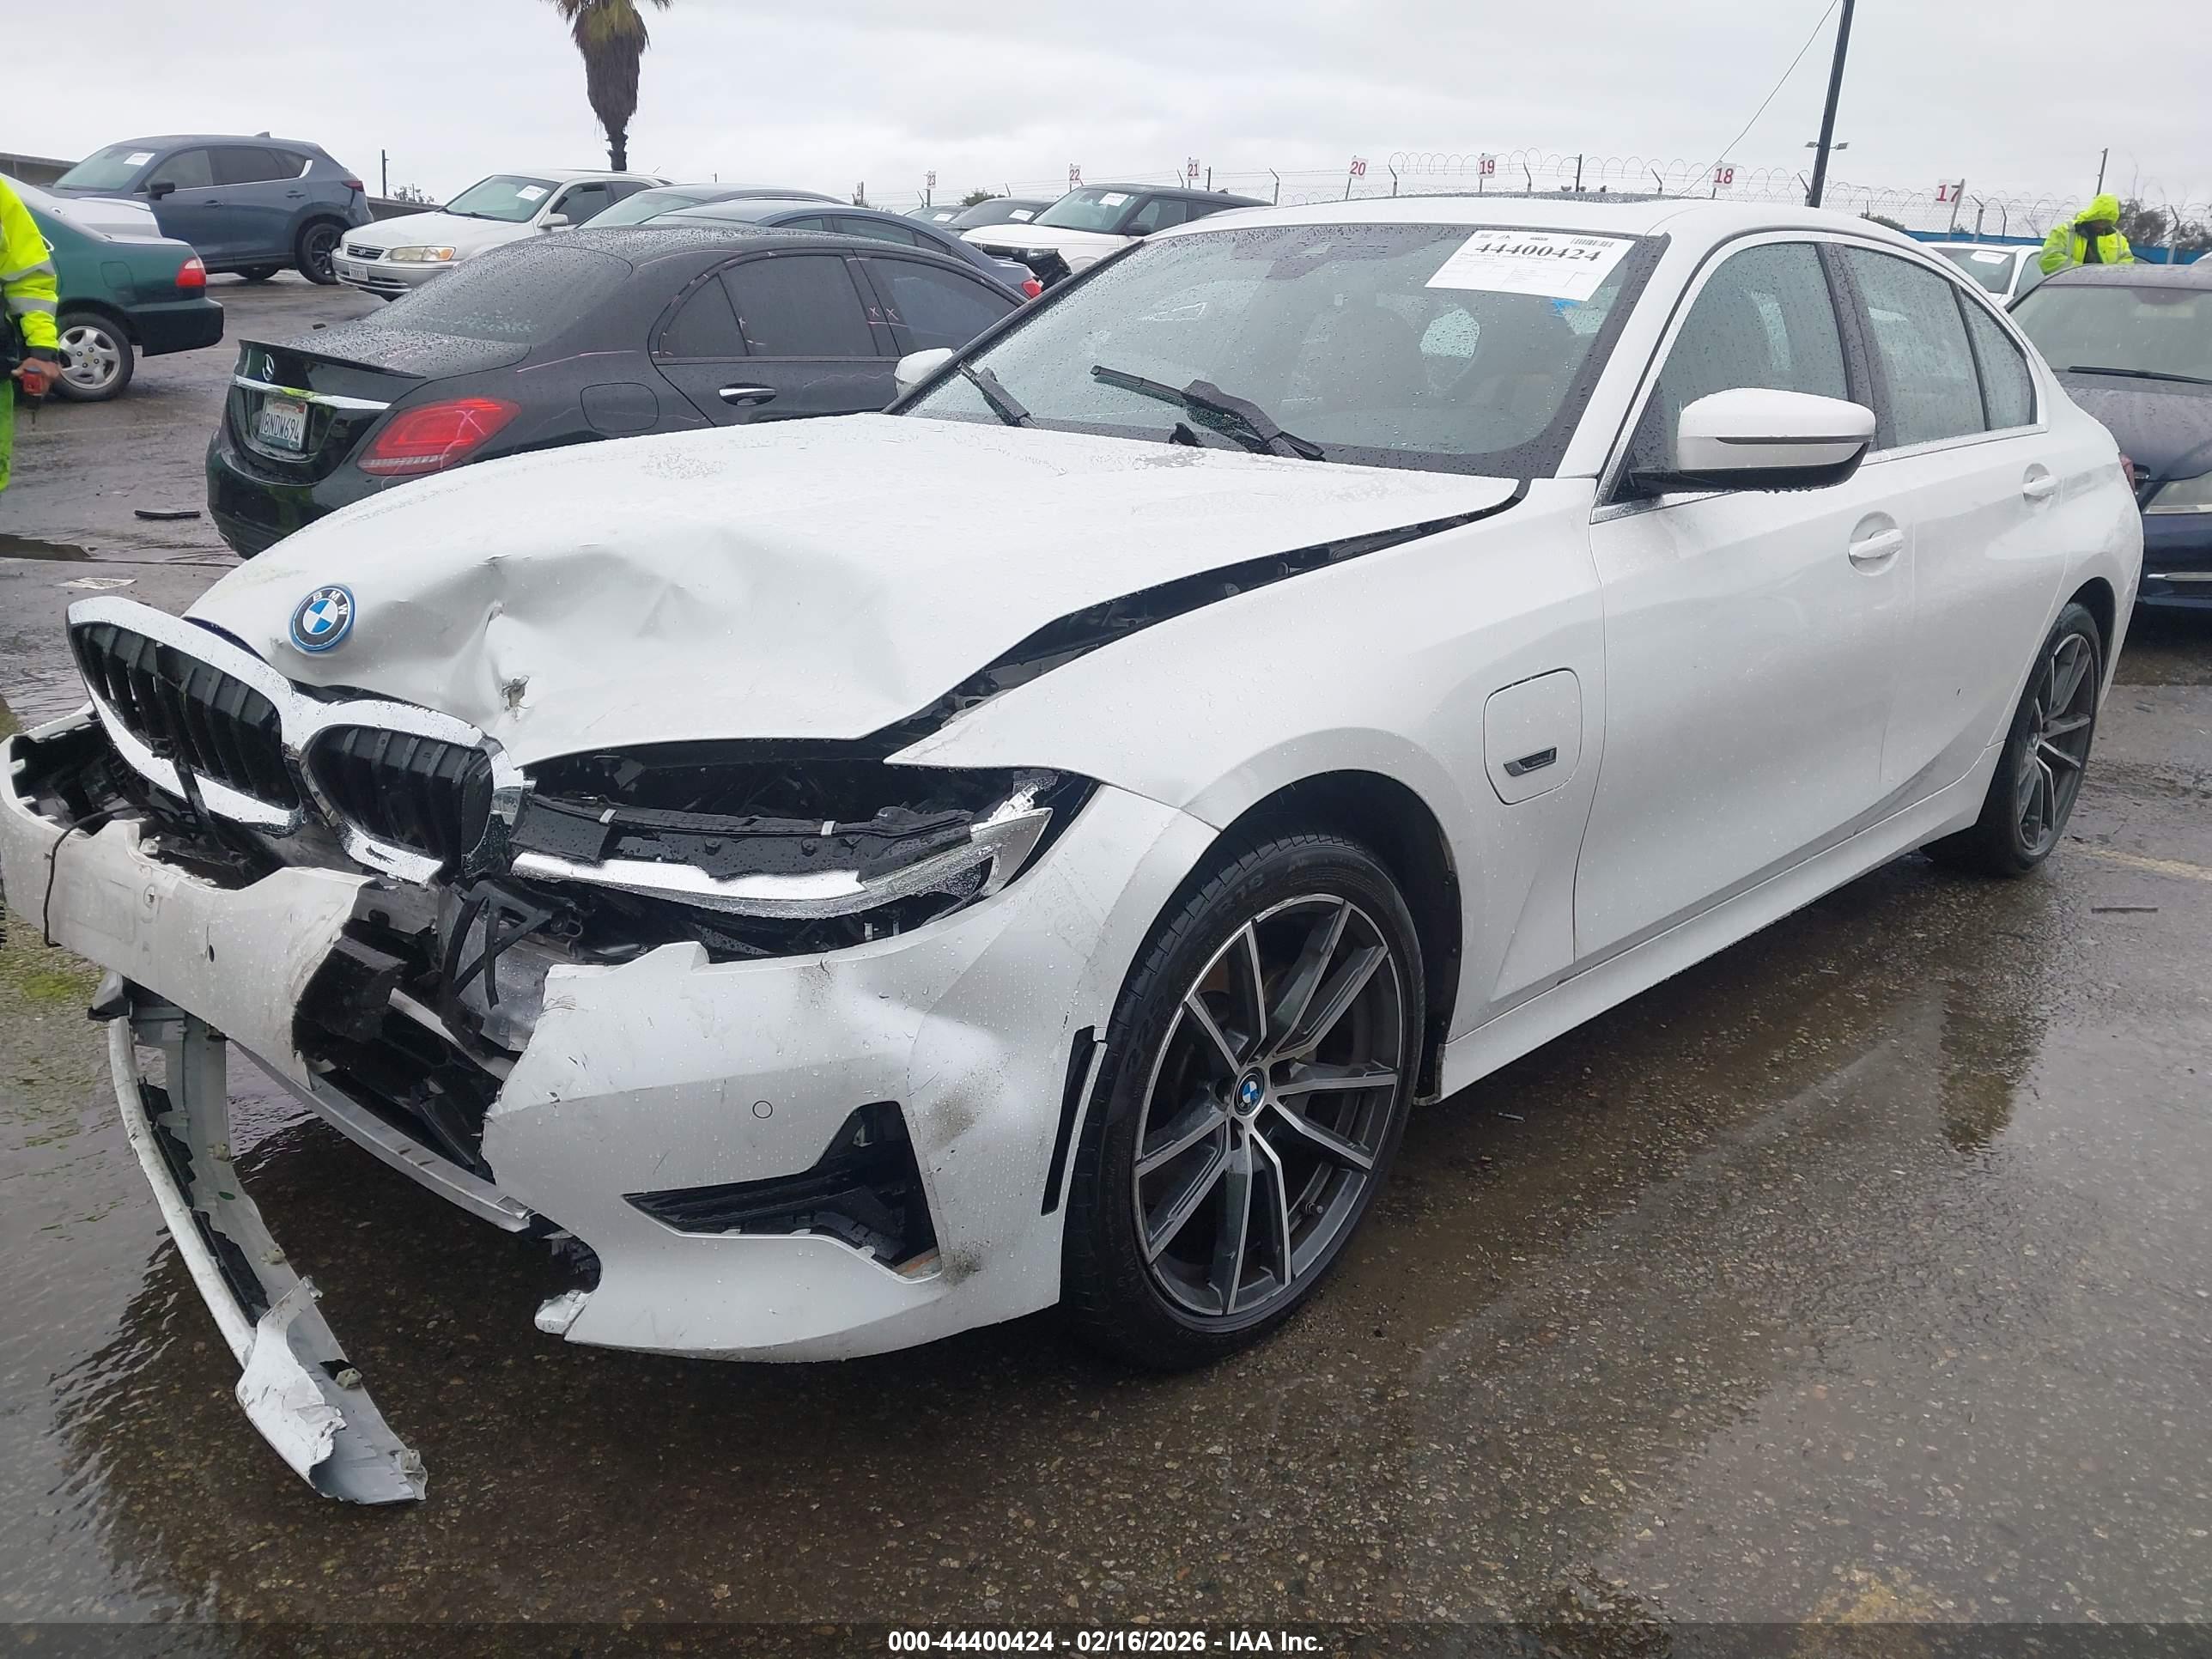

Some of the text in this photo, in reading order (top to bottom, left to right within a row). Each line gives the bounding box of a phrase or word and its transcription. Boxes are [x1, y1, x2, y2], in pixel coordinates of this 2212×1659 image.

[1069, 169, 1080, 181] 22
[1188, 164, 1199, 177] 21
[1349, 161, 1366, 176] 20
[1479, 160, 1495, 175] 19
[927, 174, 936, 186] 23
[1714, 167, 1734, 184] 18
[1936, 185, 1960, 203] 17
[1474, 242, 1602, 261] 44400424
[313, 590, 348, 615] BMW
